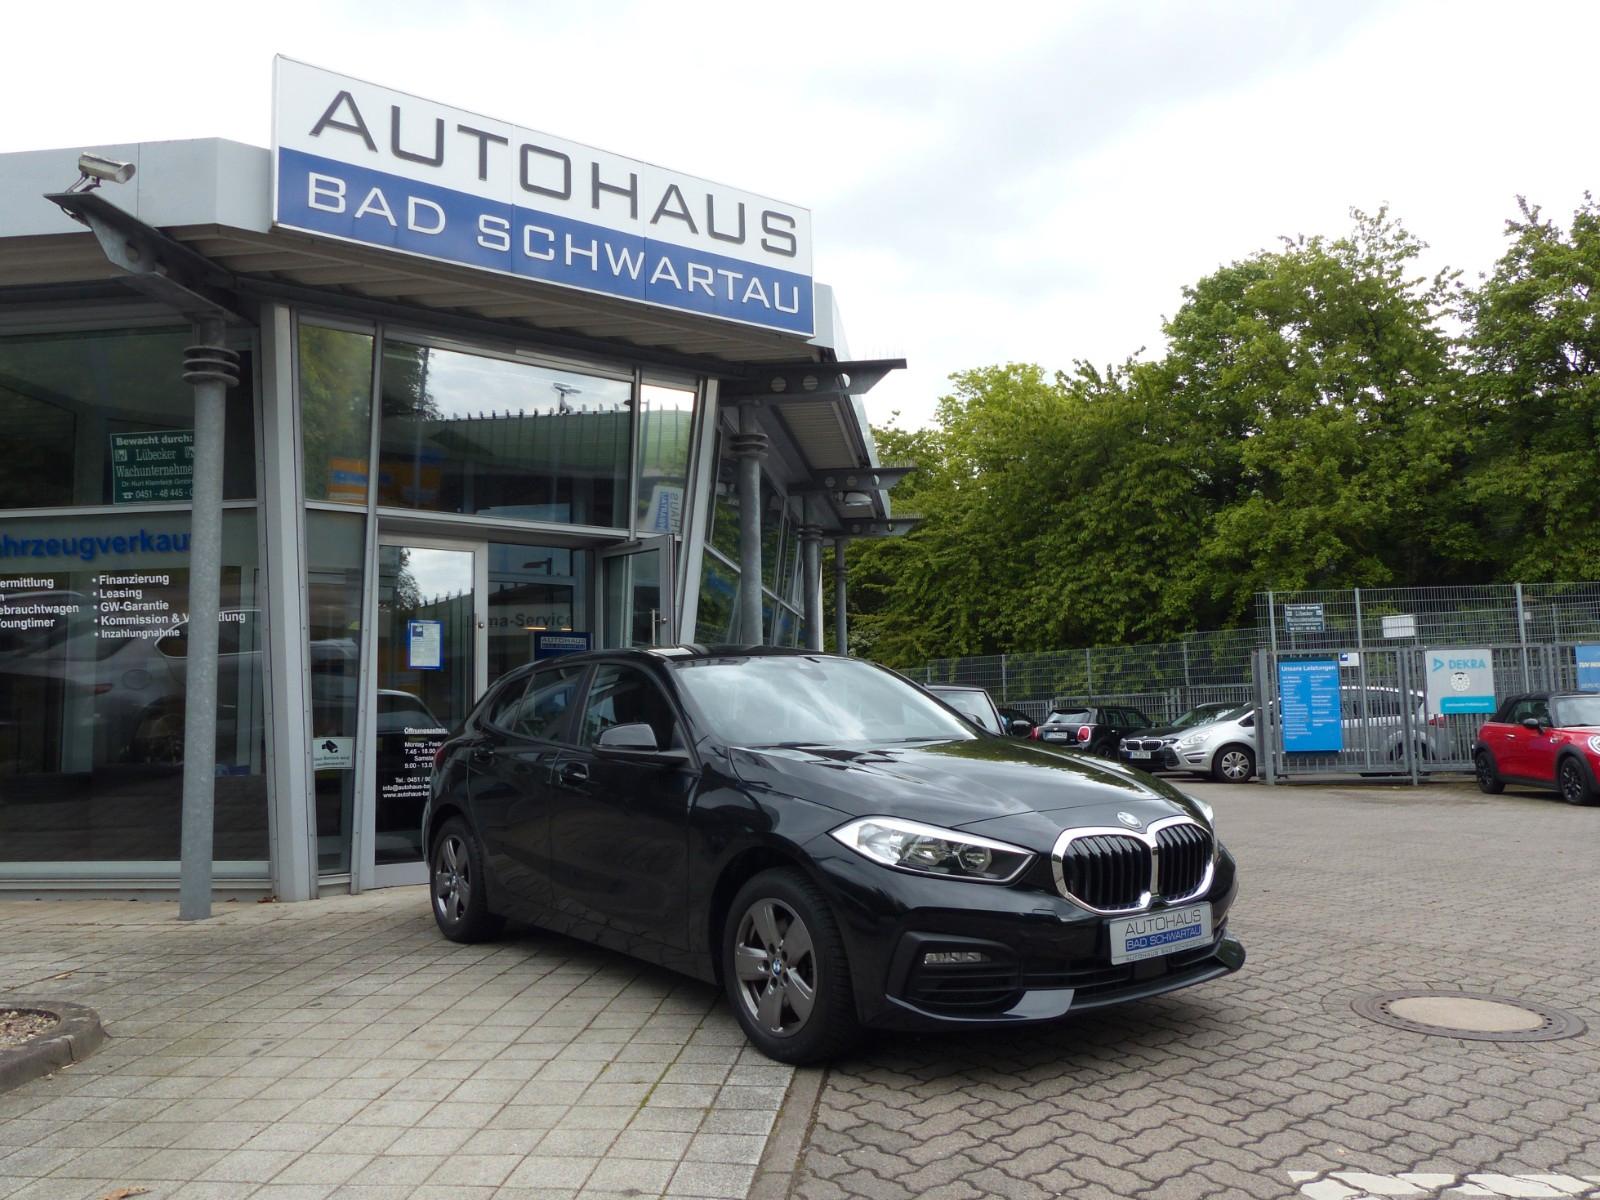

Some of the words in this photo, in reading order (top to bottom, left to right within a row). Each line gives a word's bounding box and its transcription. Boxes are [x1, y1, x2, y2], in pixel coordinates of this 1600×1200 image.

[308, 90, 798, 258] AUTOHAUS
[307, 172, 447, 236] BAD
[477, 215, 800, 315] SCHWARTAU
[115, 435, 160, 446] Bewacht
[161, 434, 193, 444] durch:
[135, 447, 177, 461] Lübecker
[115, 463, 193, 478] Wachunternehme
[135, 489, 153, 499] 0451
[0, 529, 193, 561] hrzeugverkau
[0, 577, 54, 589] ermittlung
[99, 573, 170, 585] Finanzierung
[100, 587, 143, 599] Leasing
[0, 604, 80, 616] ebrauchtwagen
[100, 600, 169, 612] GW-Garantie
[101, 613, 169, 625] Kommission
[171, 613, 180, 623] &
[101, 627, 180, 639] Inzahlungnahme
[1449, 659, 1487, 669] DEKRA
[382, 783, 431, 791] info@autohaus-ba
[383, 790, 430, 798] www.autohaus-ba
[1125, 909, 1201, 937] AUTOHAUS
[1126, 938, 1148, 950] BAD
[1149, 926, 1201, 946] SCHWARTAU
